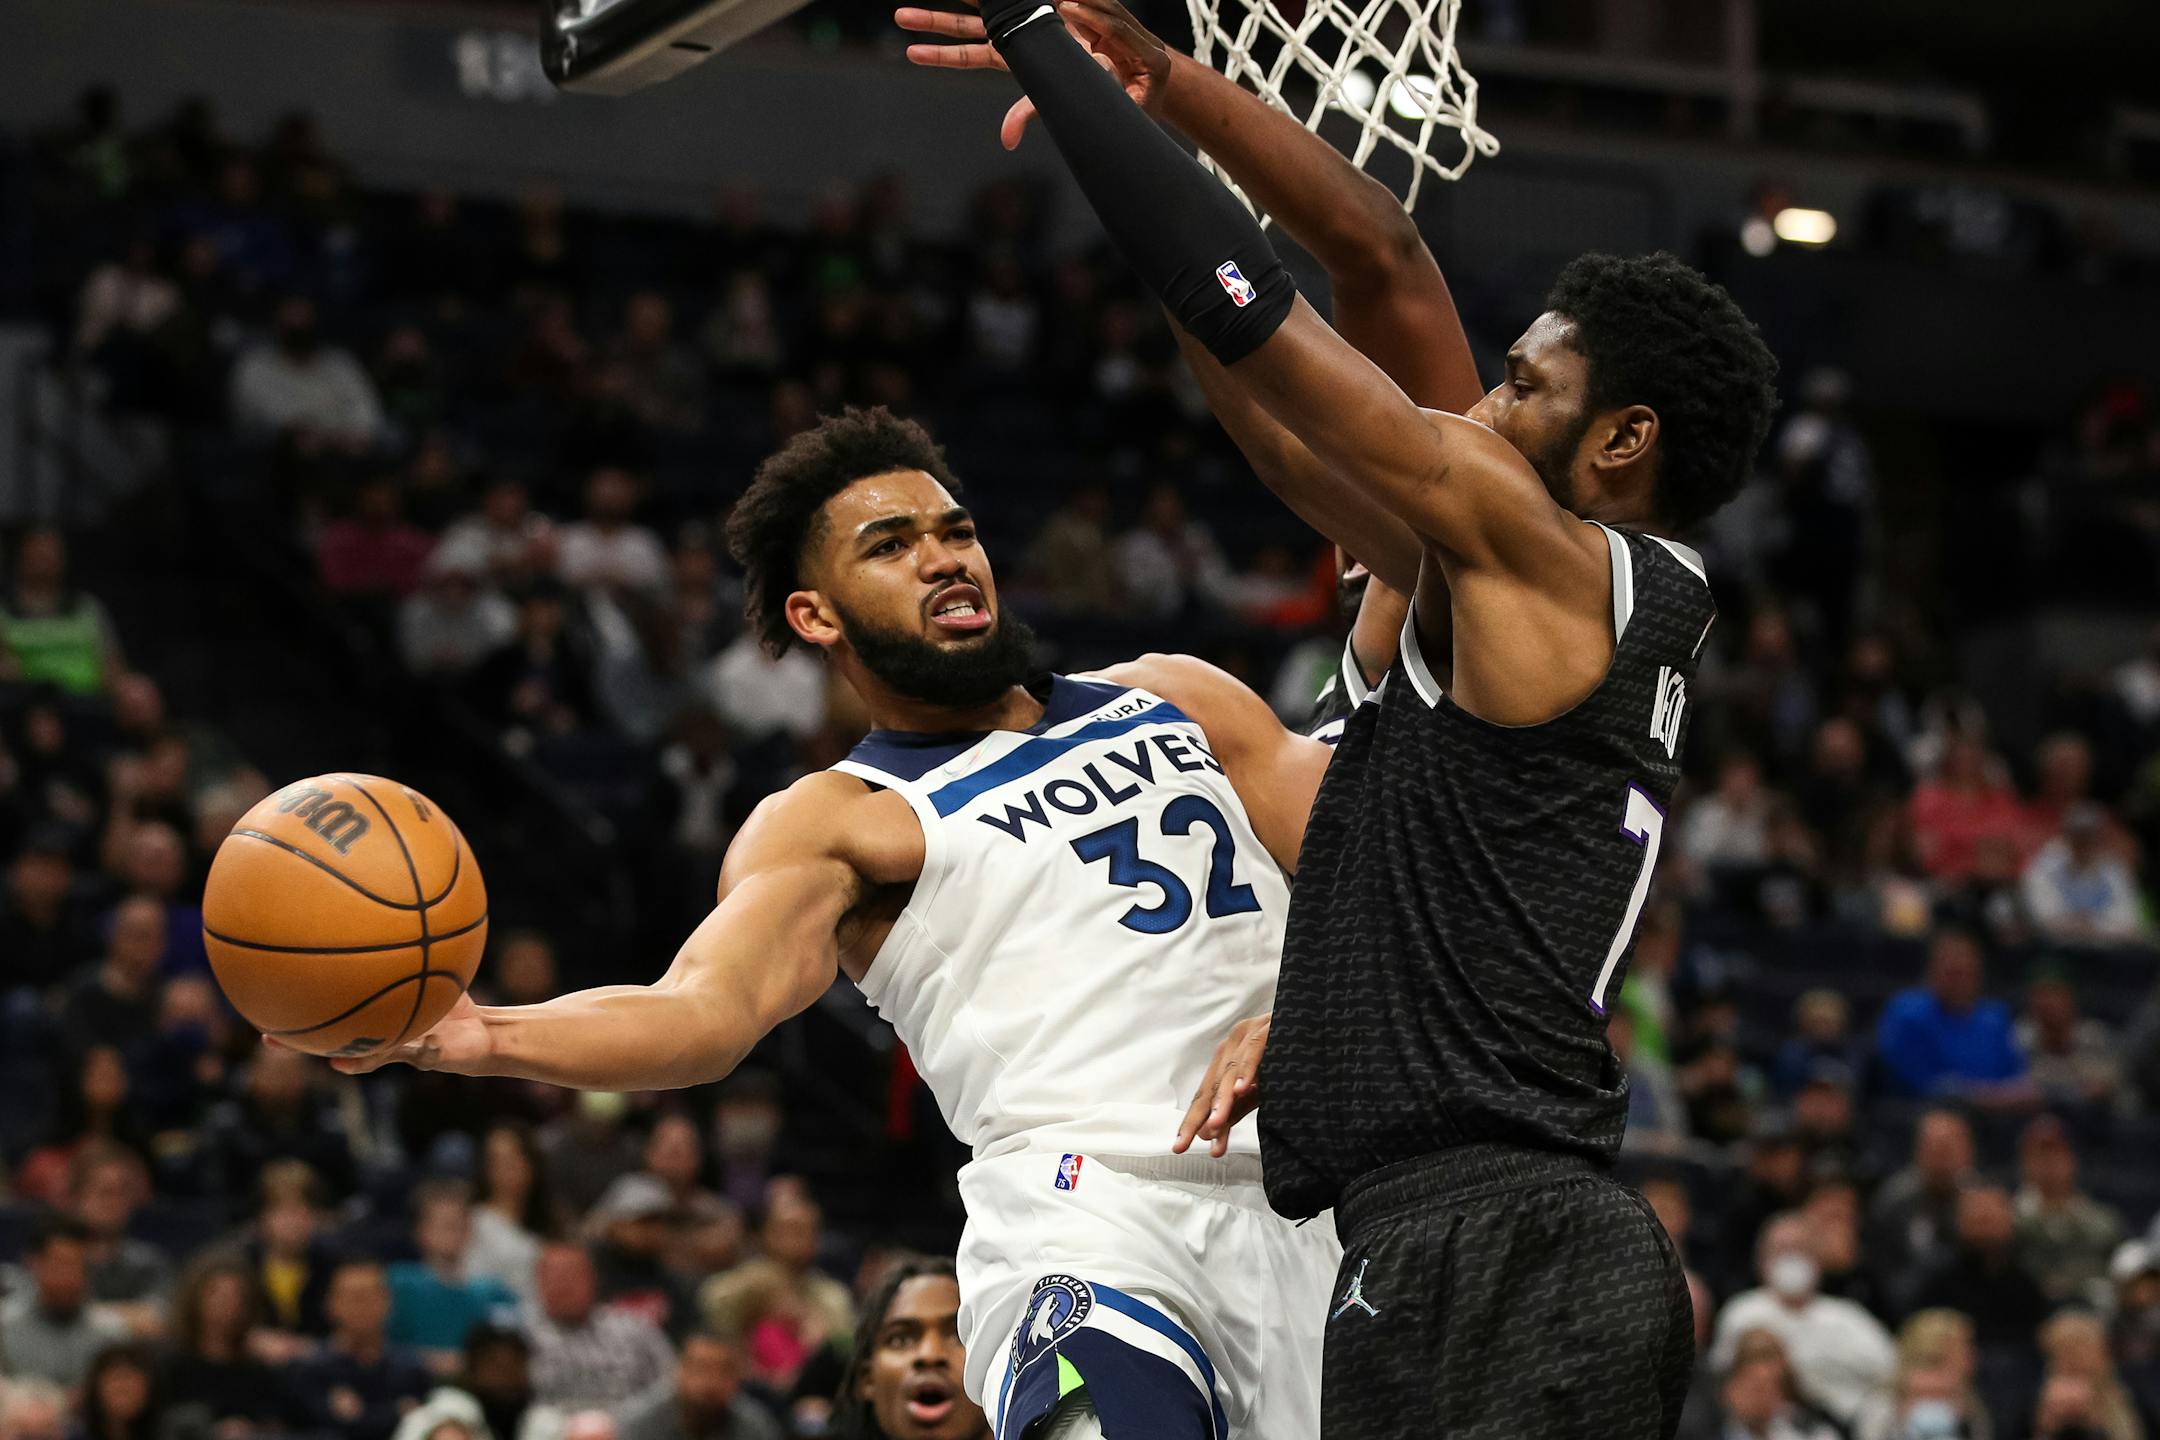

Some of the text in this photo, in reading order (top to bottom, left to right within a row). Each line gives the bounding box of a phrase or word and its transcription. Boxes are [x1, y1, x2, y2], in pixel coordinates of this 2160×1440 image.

[1090, 698, 1152, 721] URA
[977, 734, 1225, 843] WOLVES
[1069, 794, 1262, 934] 32
[1589, 781, 1666, 1015] 7
